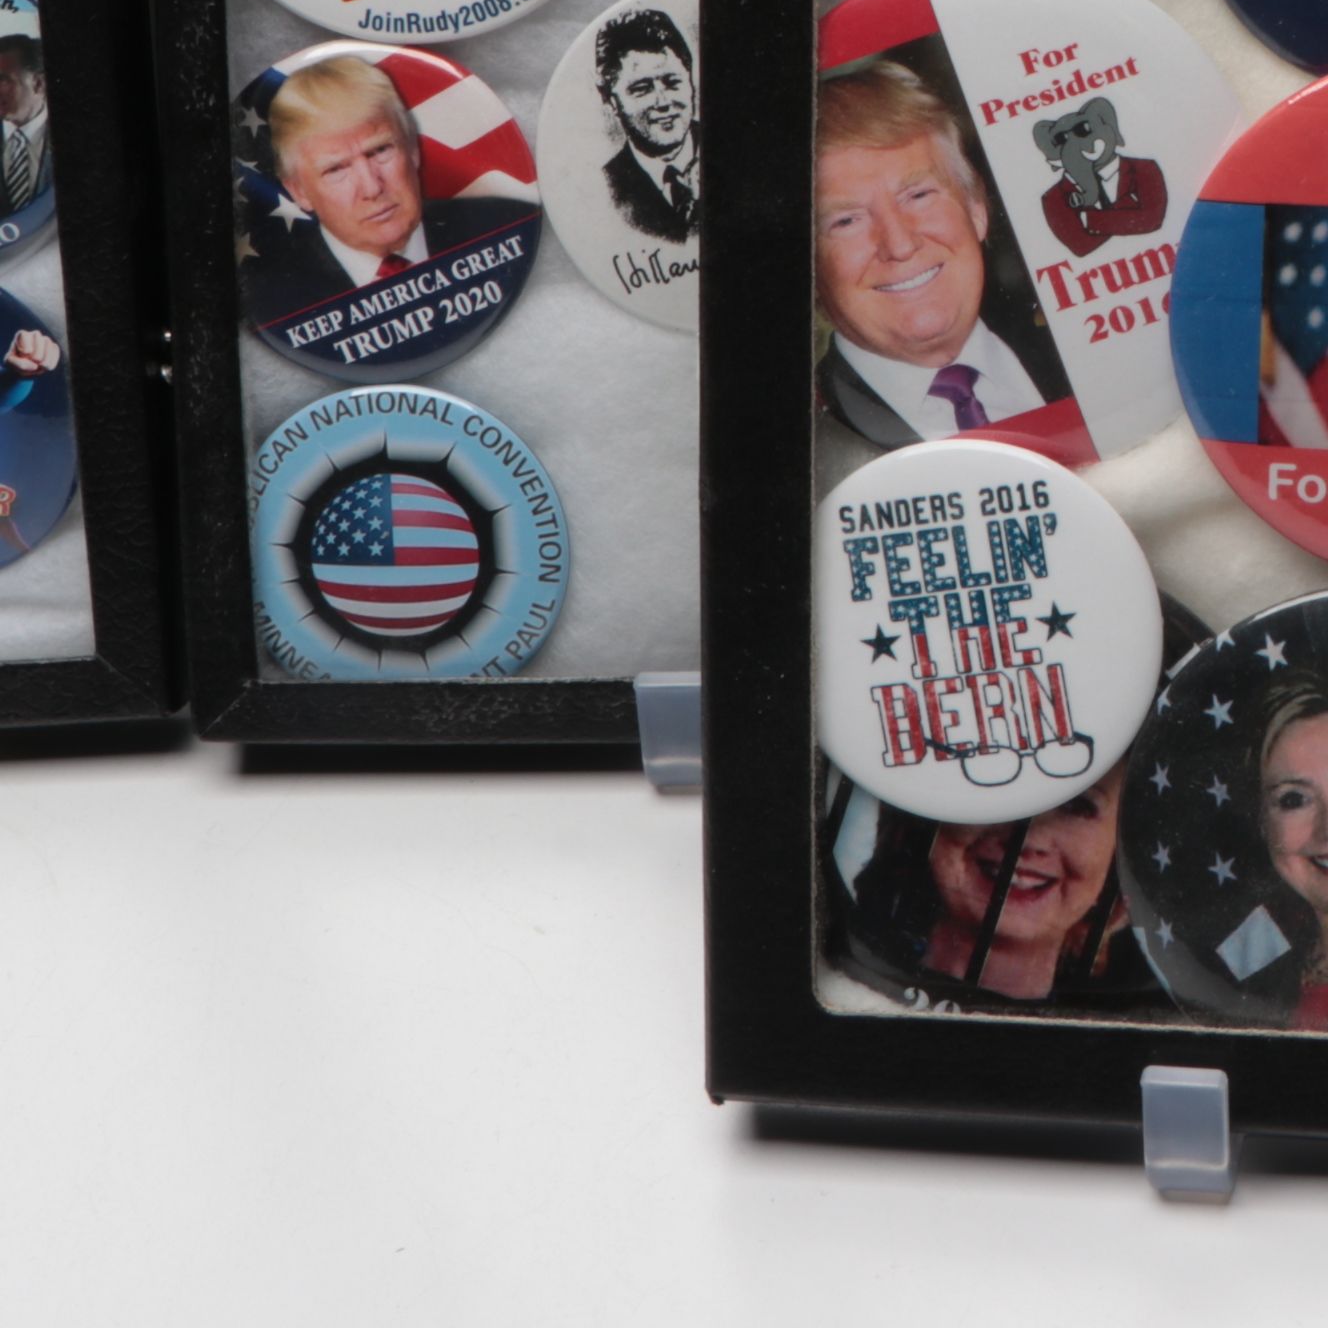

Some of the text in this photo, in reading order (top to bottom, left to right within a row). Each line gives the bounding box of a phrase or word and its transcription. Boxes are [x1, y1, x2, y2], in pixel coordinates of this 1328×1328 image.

[978, 56, 1140, 126] President
[1017, 42, 1079, 77] For
[285, 235, 525, 349] KEEP AMERICA GREAT
[1036, 241, 1179, 312] Trum
[333, 280, 503, 365] TRUMP 2020
[309, 390, 454, 431] NATIONAL
[463, 414, 563, 585] CONVENTION
[839, 480, 1050, 534] SANDERS 2016
[504, 598, 557, 661] PAUL
[888, 583, 1043, 679] THE
[870, 663, 1077, 768] BERN
